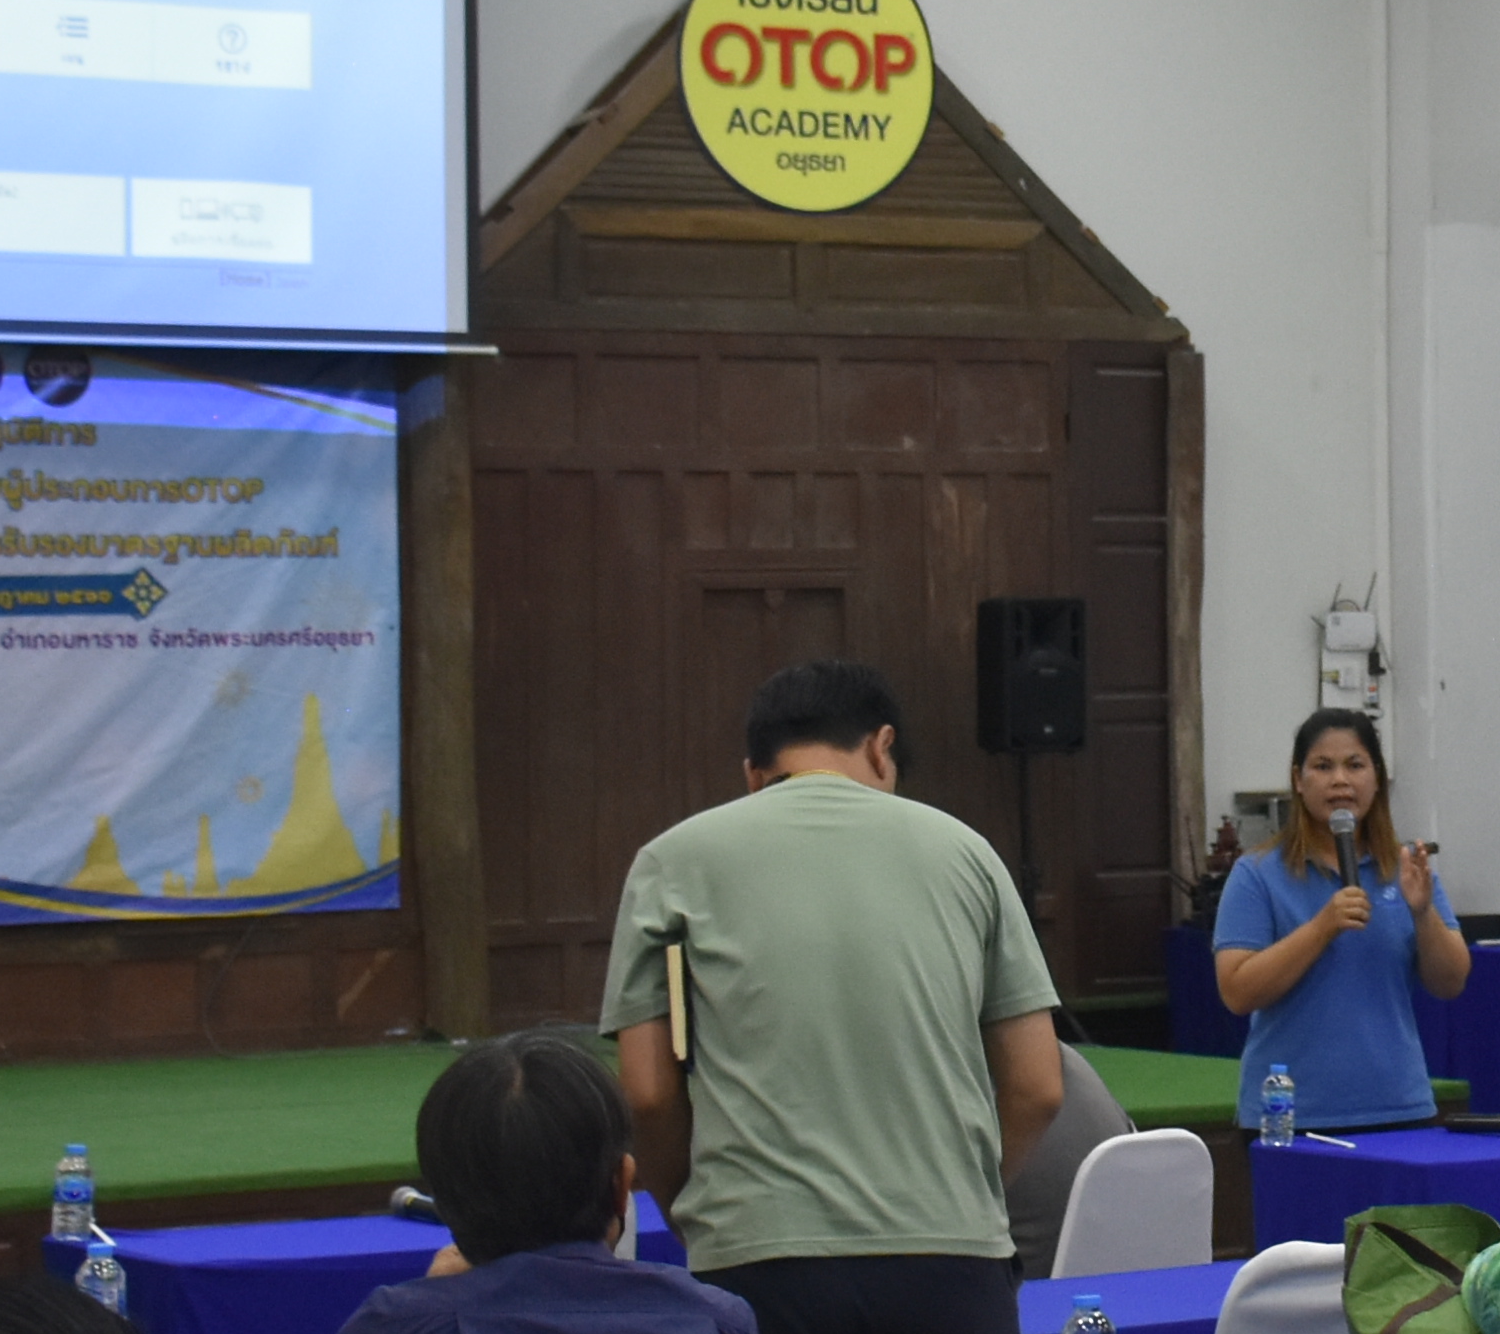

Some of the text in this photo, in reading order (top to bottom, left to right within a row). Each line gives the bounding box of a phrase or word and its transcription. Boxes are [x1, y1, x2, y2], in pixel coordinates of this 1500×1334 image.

[700, 21, 918, 94] OTOP
[726, 107, 893, 142] ACADEMY
[776, 151, 847, 177] อยุธยา
[1, 627, 139, 652] อำเภอมหาราช
[148, 625, 376, 654] จังหวัดพระนครศรีอยุธยา
